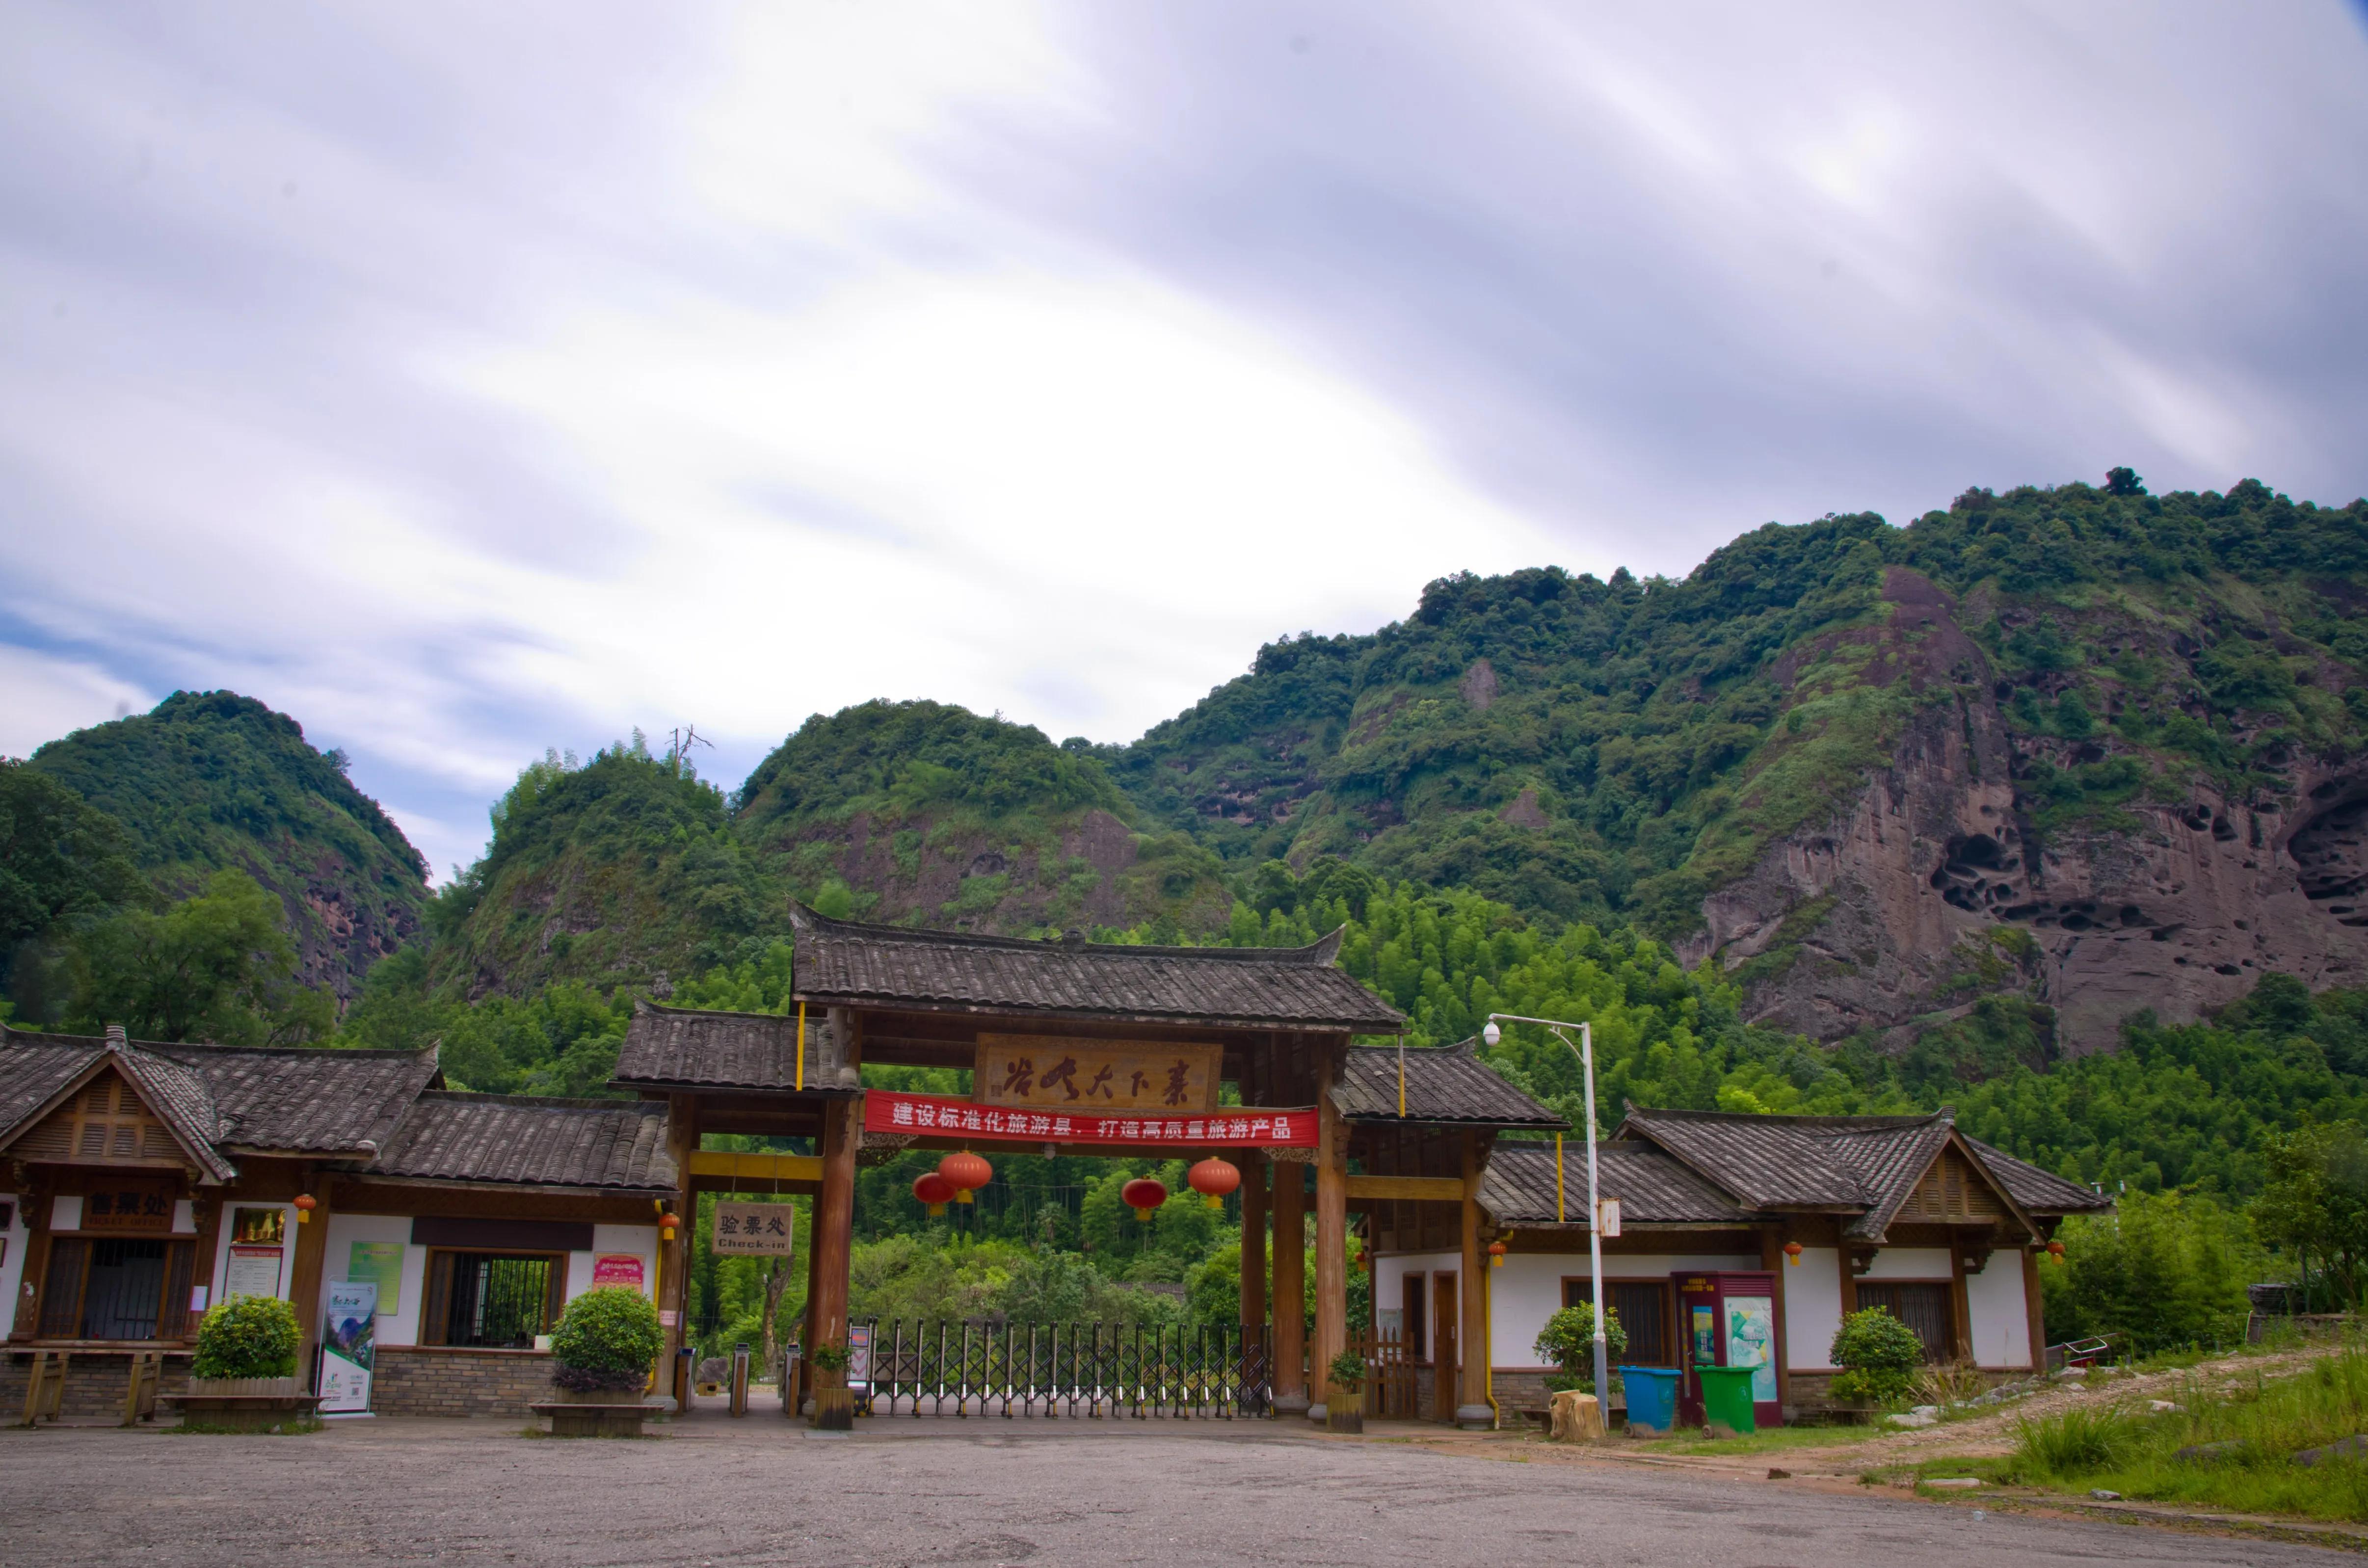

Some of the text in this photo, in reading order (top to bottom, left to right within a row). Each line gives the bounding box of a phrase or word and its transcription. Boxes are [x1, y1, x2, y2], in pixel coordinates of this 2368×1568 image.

[90, 1191, 168, 1216] 售票处
[719, 1215, 786, 1236] 验票处
[718, 1238, 785, 1249] Check-in
